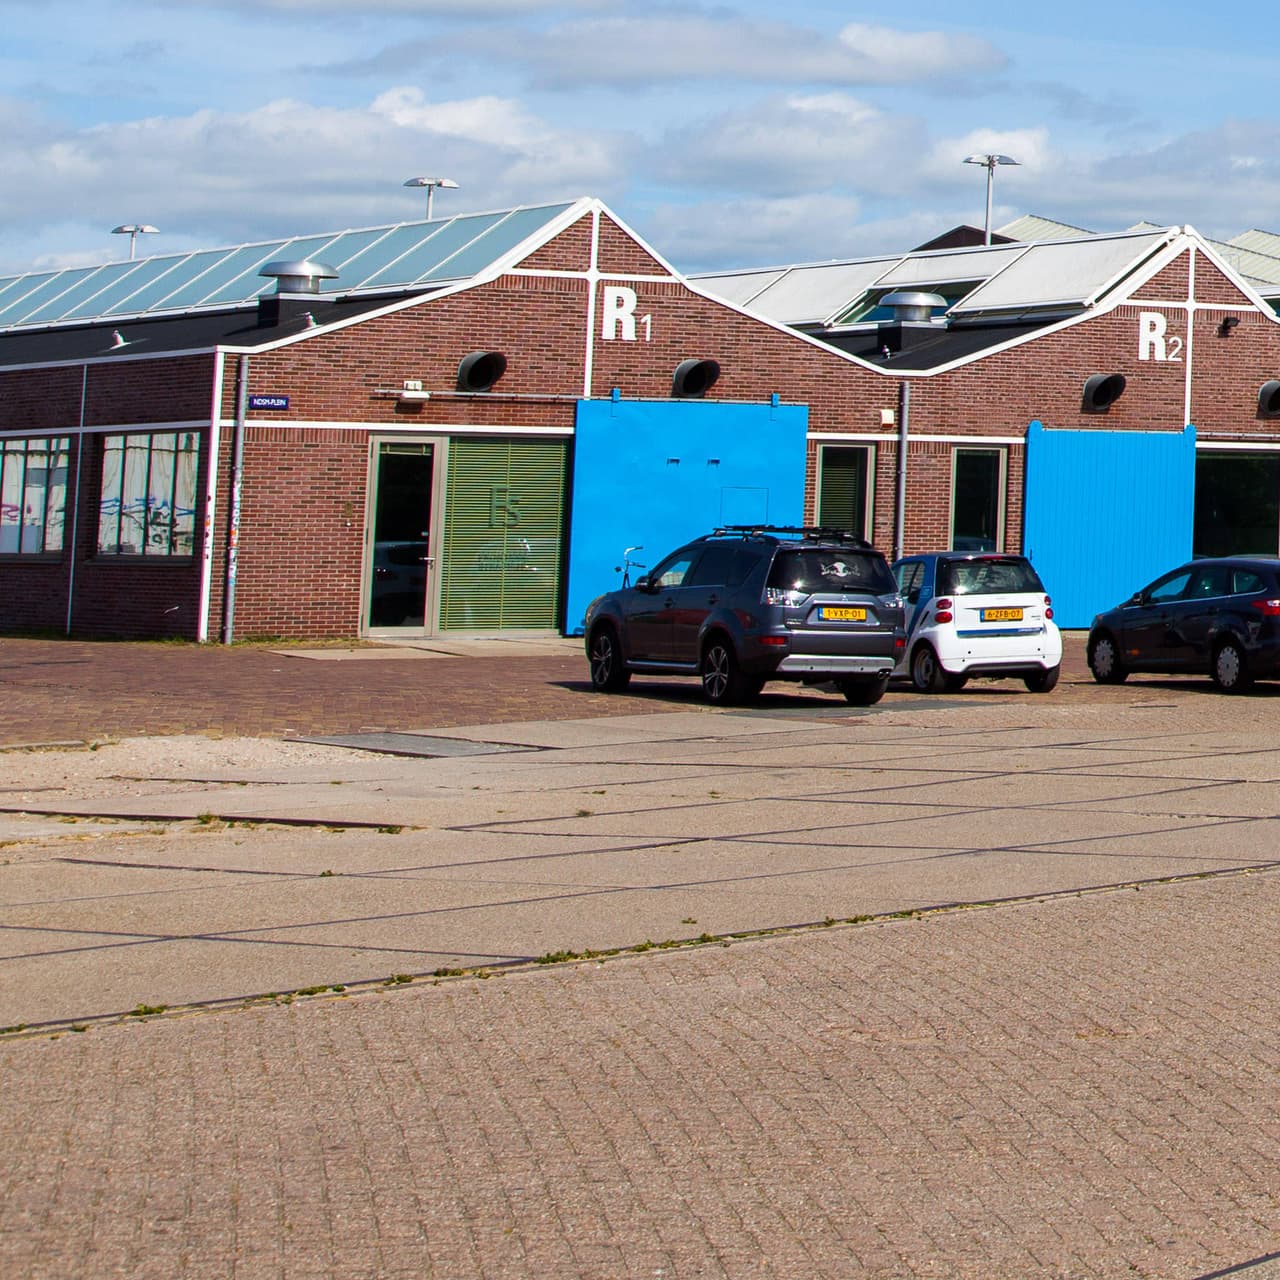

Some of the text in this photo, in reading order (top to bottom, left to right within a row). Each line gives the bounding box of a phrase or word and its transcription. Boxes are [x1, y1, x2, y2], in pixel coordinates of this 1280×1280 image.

[602, 285, 652, 342] R1
[1138, 311, 1183, 362] R2
[827, 608, 861, 618] 1-VXP-01
[987, 610, 1020, 618] 6-ZFB-07
